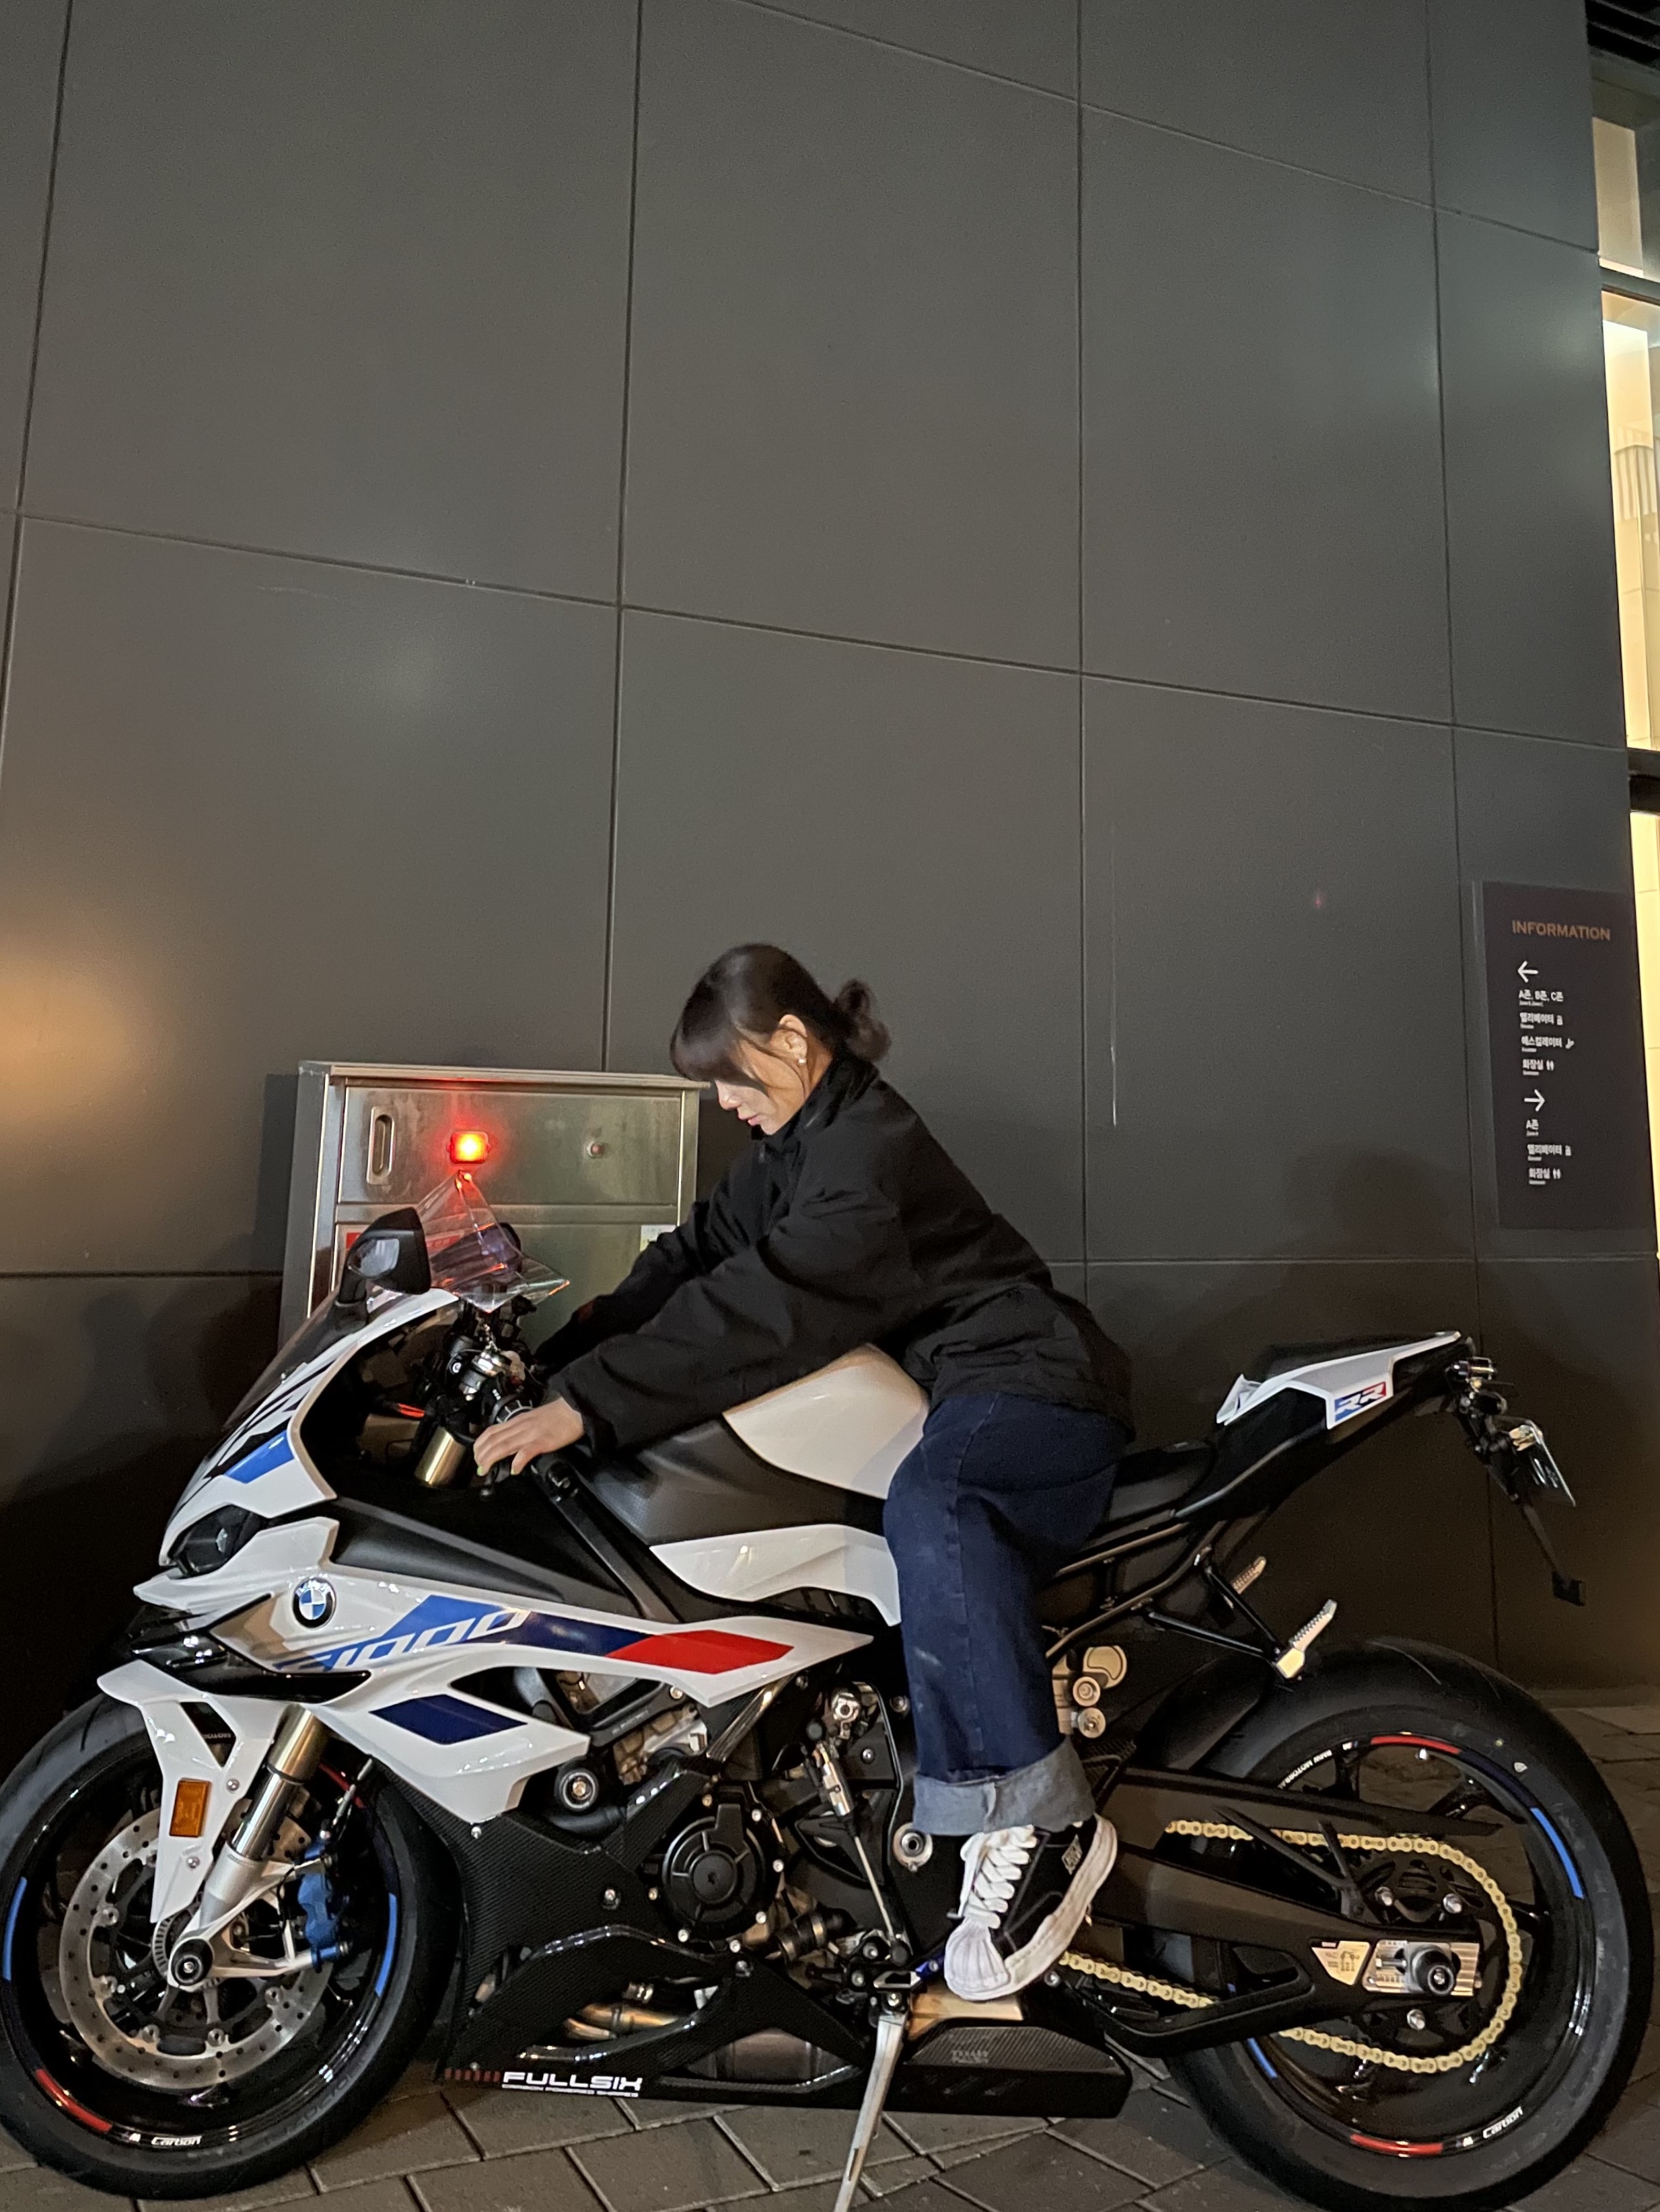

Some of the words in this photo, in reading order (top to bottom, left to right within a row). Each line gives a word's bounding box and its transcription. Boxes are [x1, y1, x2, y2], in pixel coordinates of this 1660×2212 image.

[1512, 920, 1611, 941] INFORMATION
[1520, 1012, 1554, 1025] 엘리베이터
[1521, 1035, 1562, 1047] 에스컬레이터
[1523, 1059, 1544, 1070] 화장실
[1527, 1144, 1562, 1156] 엘리베이터
[1529, 1167, 1550, 1179] 화장실
[503, 2071, 643, 2091] FULLSIX
[1482, 2106, 1523, 2139] Carbon
[151, 2135, 203, 2146] Carbon
